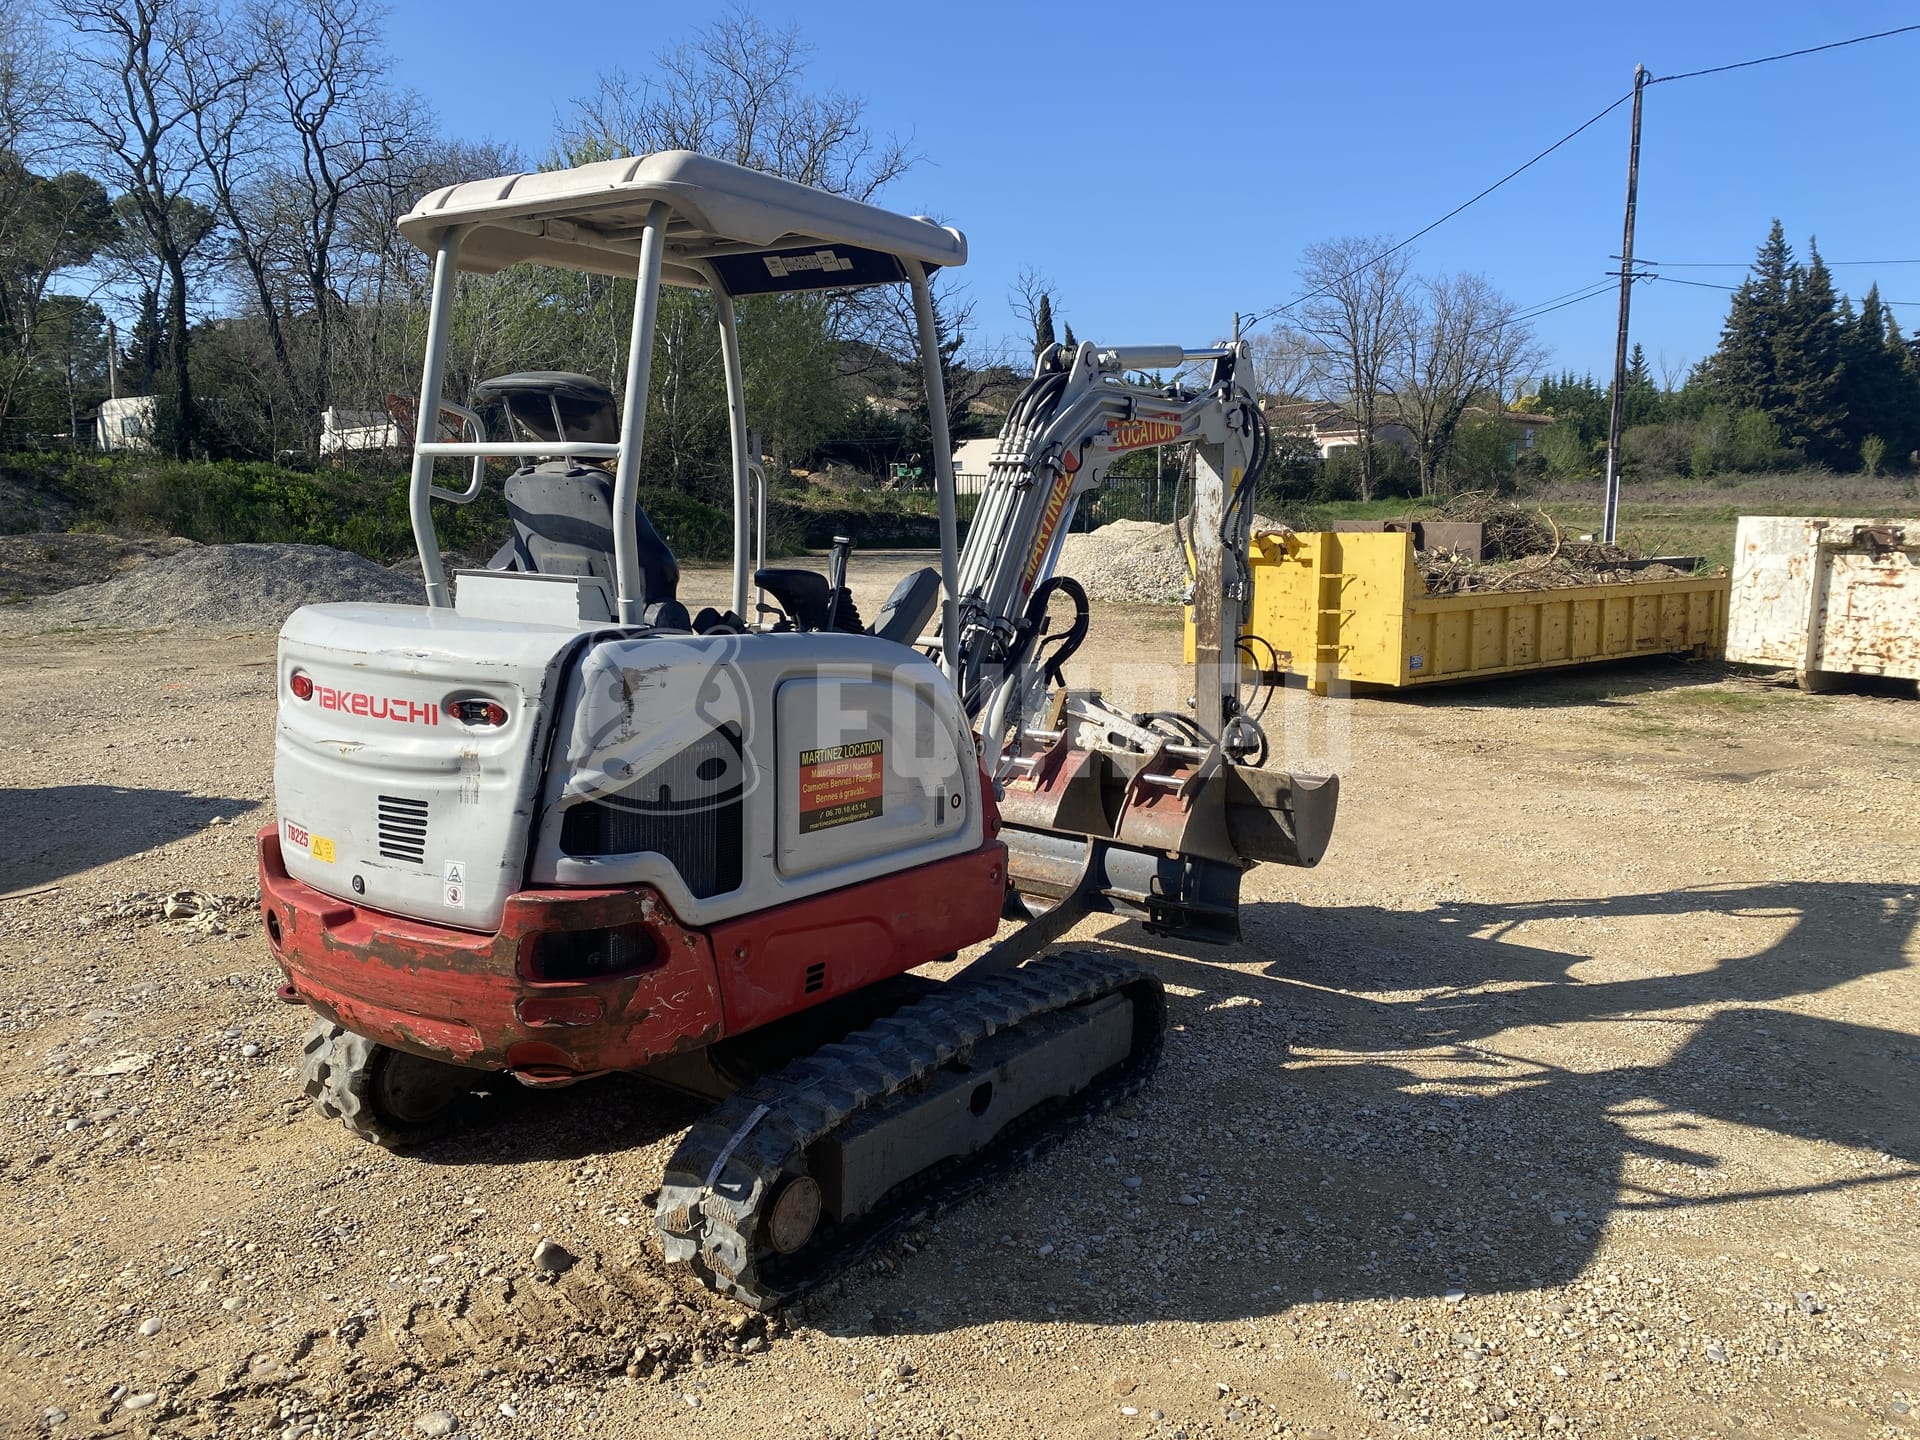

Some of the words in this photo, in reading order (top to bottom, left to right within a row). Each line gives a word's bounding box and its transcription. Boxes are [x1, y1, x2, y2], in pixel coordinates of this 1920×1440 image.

[314, 685, 438, 726] TAKEUCHI
[801, 747, 843, 765] MARTINEZ
[844, 741, 882, 757] LOCATION
[836, 763, 849, 775] BTP
[802, 782, 829, 793] Camions
[830, 777, 852, 789] Bennes
[855, 772, 880, 783] Fourgons
[815, 792, 839, 804] Bennes
[287, 824, 309, 848] TB225
